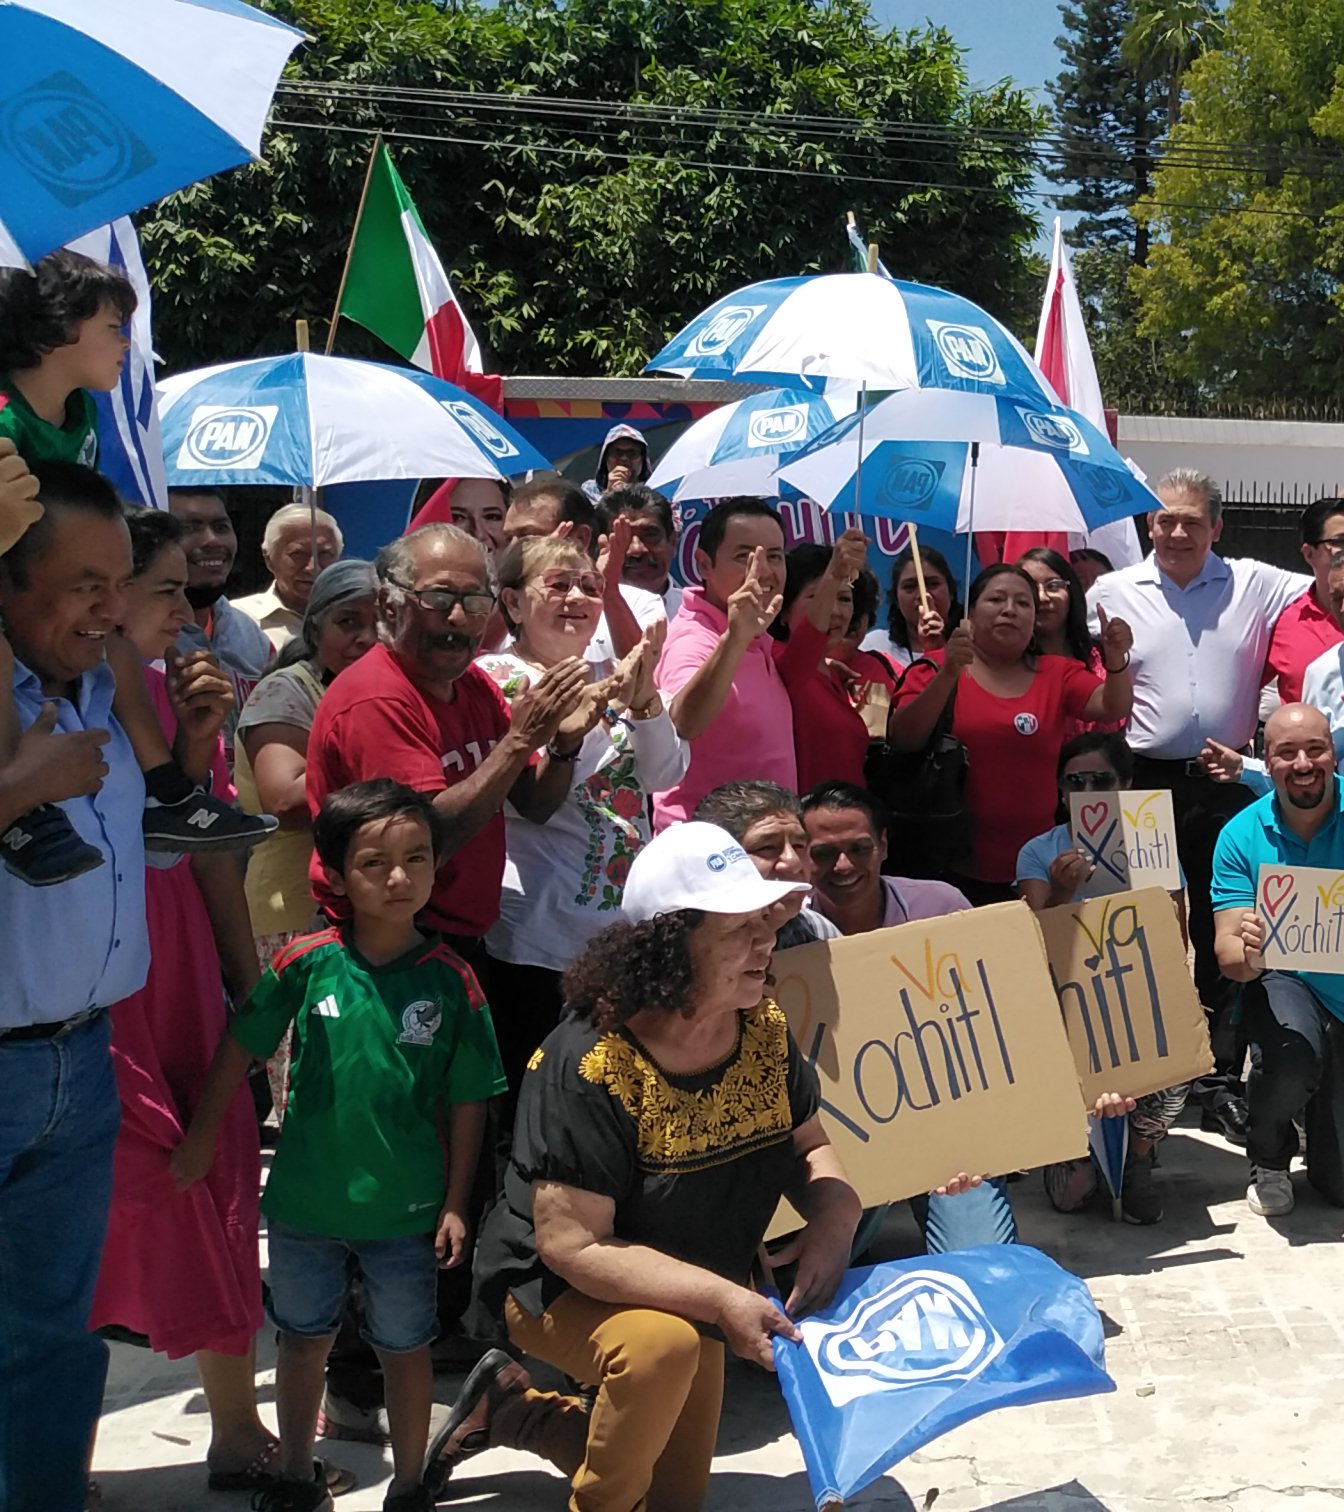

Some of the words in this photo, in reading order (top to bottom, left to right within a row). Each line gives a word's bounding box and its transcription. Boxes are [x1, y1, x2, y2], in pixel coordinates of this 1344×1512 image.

[944, 334, 989, 367] PAN
[198, 421, 257, 451] PAN
[760, 414, 797, 435] PAN
[187, 808, 220, 829] N
[1123, 792, 1162, 829] Va
[2, 827, 32, 850] N
[1077, 818, 1170, 884] Xóchitl
[1071, 898, 1139, 960] Va
[890, 937, 972, 1002] Va
[1049, 925, 1169, 1074] hitl
